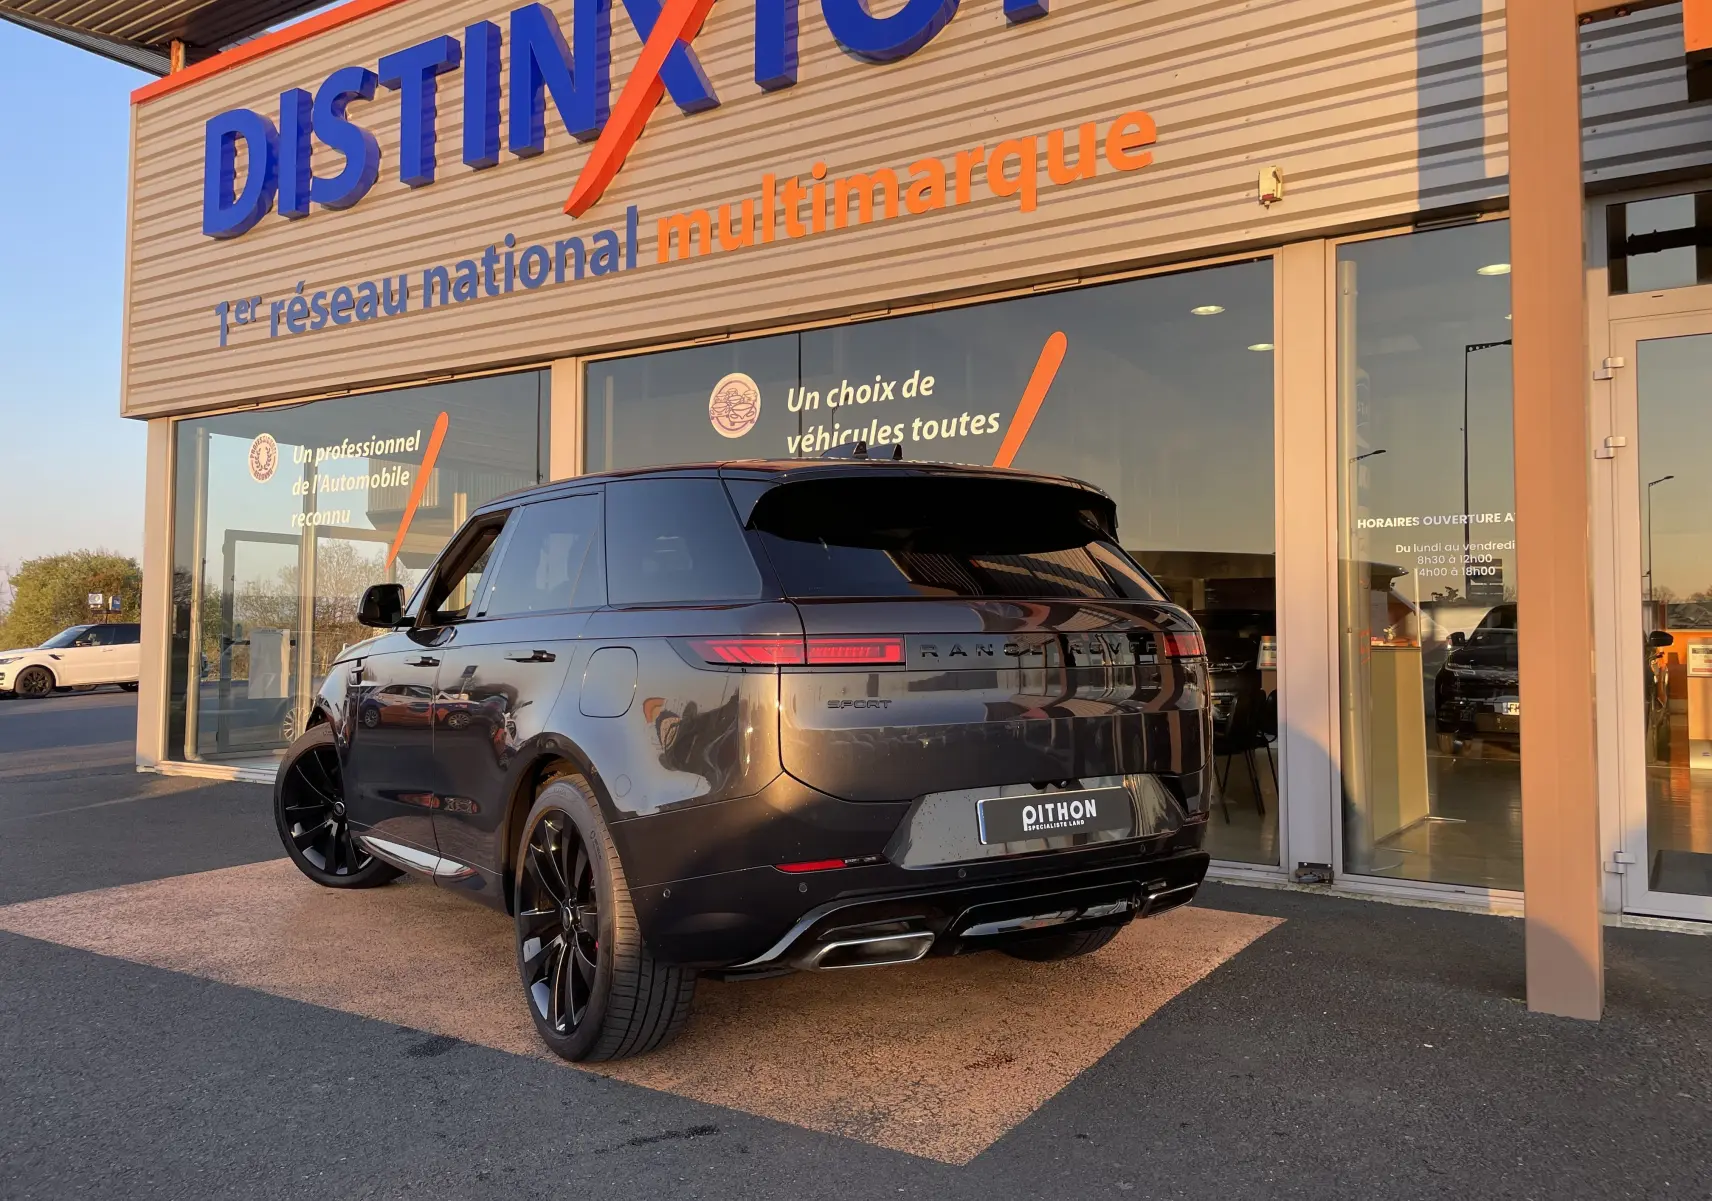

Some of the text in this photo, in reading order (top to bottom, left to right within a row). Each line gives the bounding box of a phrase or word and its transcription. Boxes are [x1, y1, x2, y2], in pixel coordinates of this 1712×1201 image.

[215, 110, 1158, 347] 1er réseau national multimarque
[787, 369, 936, 412] Un choix de
[787, 411, 1001, 454] véhicules toutes
[293, 430, 421, 468] Un professionnel
[292, 466, 410, 496] de l'Automobile
[291, 509, 351, 528] reconnu
[1357, 512, 1516, 529] HORAIRES OUVERTURE A
[1395, 540, 1516, 553] Du lundi au vendredi
[1417, 553, 1493, 565] 8h30 à 12h00
[1450, 565, 1458, 577] à
[1461, 566, 1496, 576] 18h00
[827, 699, 893, 709] SPORT
[1022, 799, 1097, 832] PITHON
[1028, 819, 1085, 831] SPECIALISTE LAND
